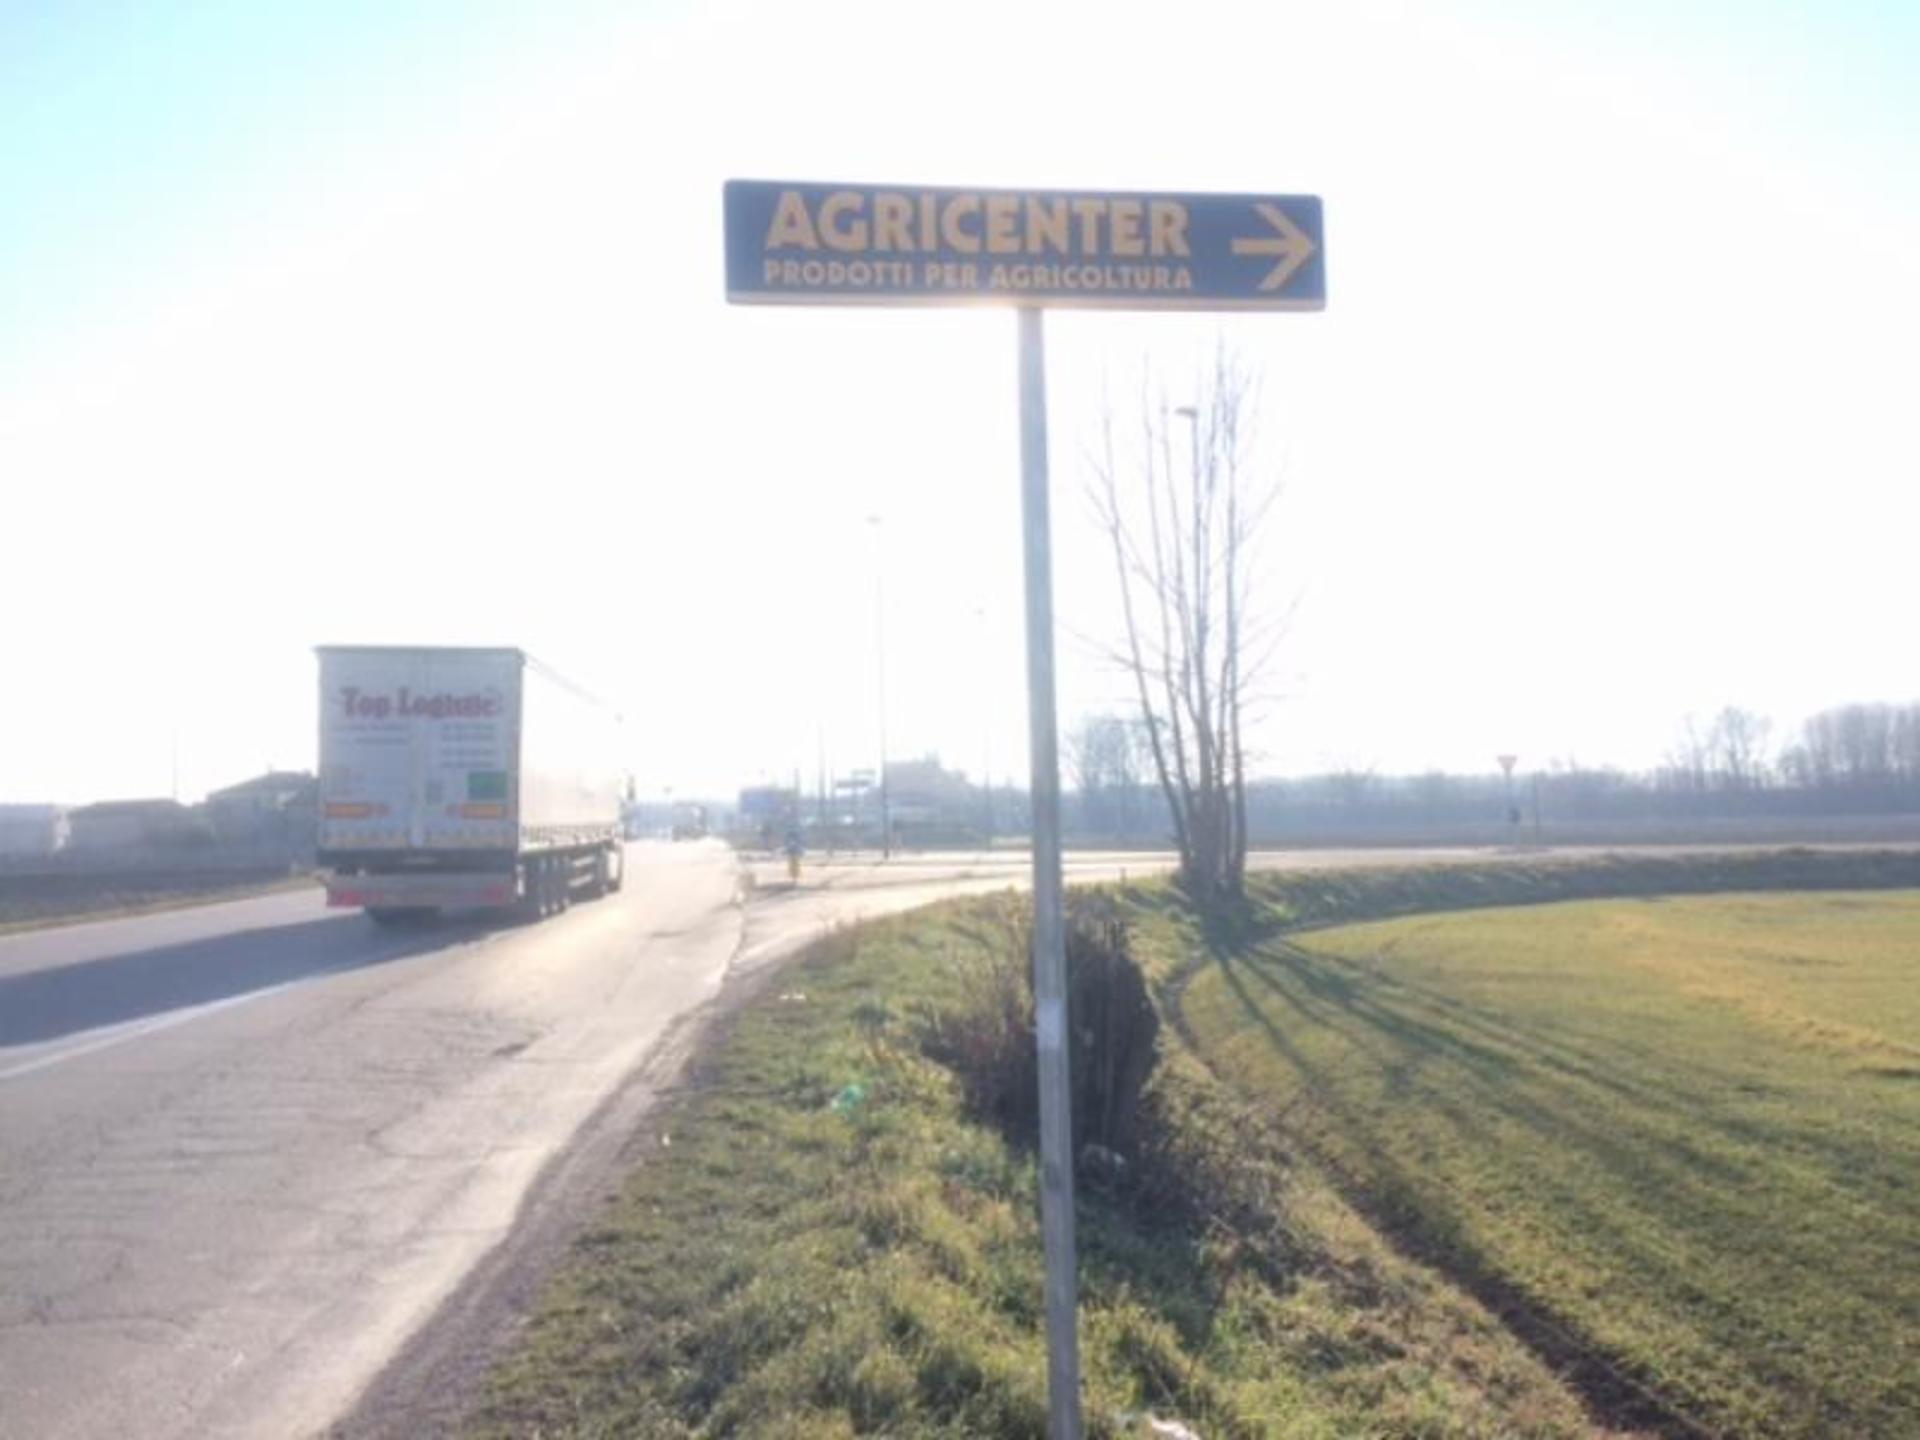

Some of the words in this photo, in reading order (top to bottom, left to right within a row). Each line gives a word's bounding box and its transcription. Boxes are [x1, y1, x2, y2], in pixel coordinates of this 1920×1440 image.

[767, 191, 1191, 256] AGRICENTER
[765, 259, 913, 286] PRODOTTI
[925, 263, 976, 288] PER
[991, 265, 1191, 289] AGRICOLTURA
[341, 686, 390, 718] Top
